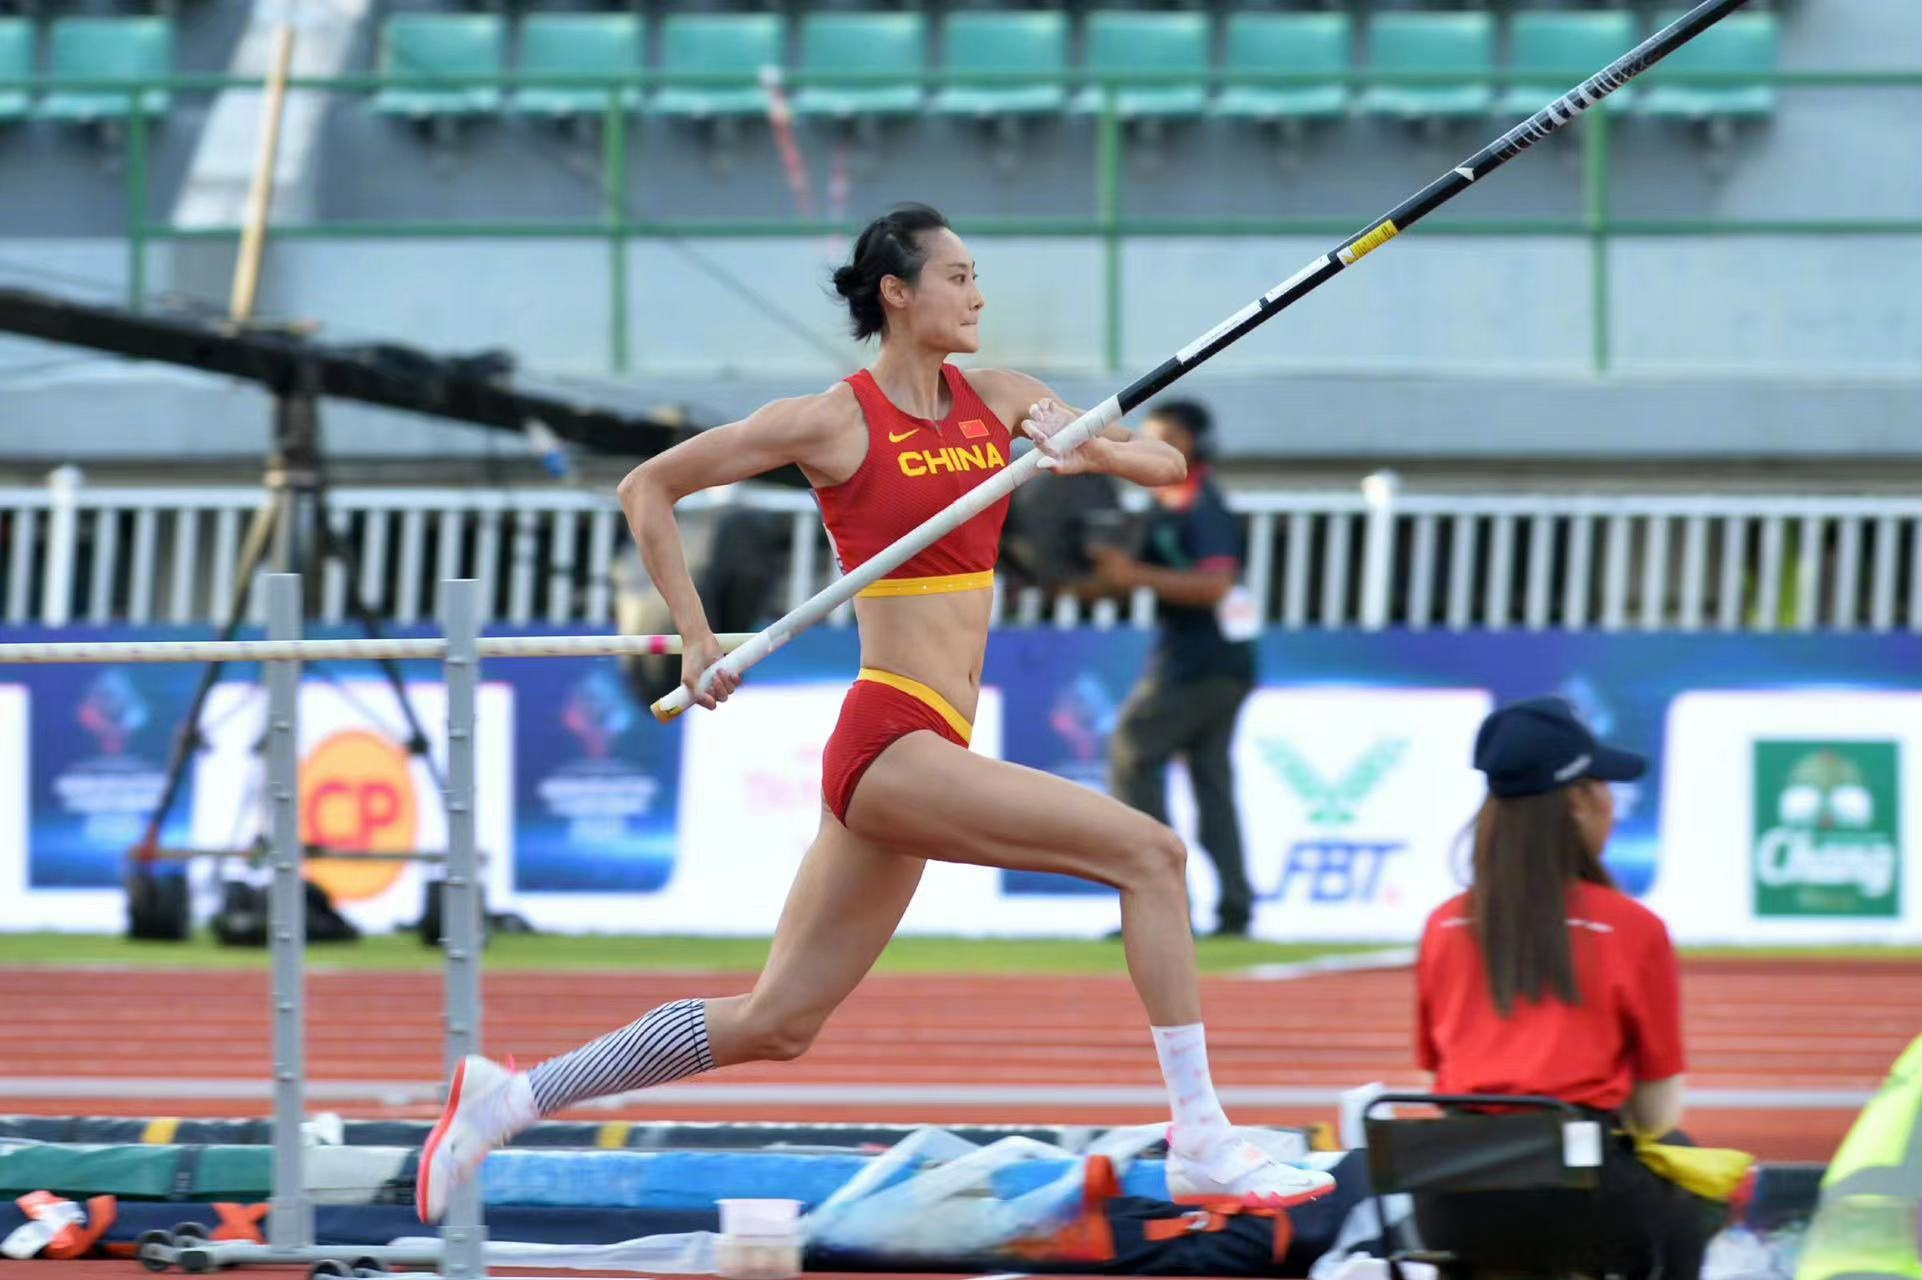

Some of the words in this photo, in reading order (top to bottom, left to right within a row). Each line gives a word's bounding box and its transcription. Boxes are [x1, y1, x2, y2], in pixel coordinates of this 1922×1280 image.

[898, 442, 1005, 477] CHINA
[306, 780, 401, 851] CP
[1257, 839, 1407, 901] FBT
